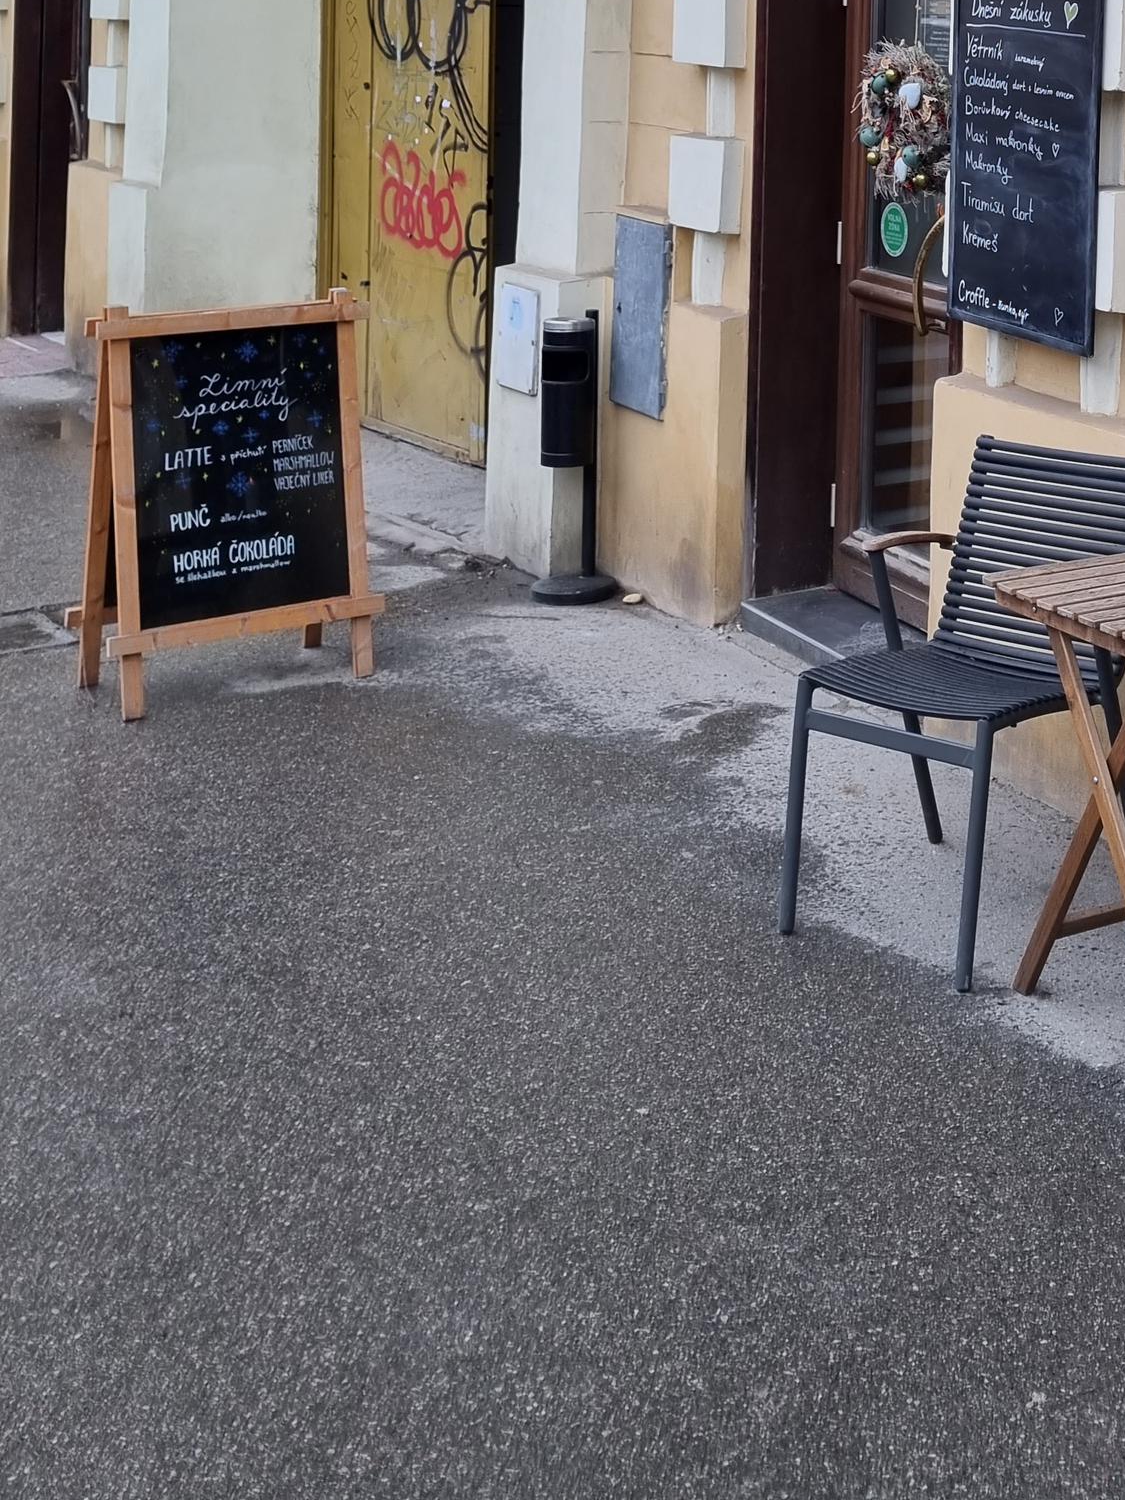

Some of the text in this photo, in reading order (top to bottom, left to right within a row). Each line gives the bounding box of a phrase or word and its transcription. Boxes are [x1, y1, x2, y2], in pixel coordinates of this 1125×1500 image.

[966, 32, 1003, 61] Větrník
[963, 58, 1010, 96] Čokoládový
[1014, 107, 1061, 133] cheesecake
[965, 122, 1044, 161] Maxi makronky
[965, 149, 1014, 185] Makronky
[961, 181, 1034, 224] Tiramisu dort
[962, 220, 998, 253] Kremeš
[958, 279, 991, 308] Croffle
[199, 367, 288, 398] Zimní
[172, 387, 299, 431] speciality
[164, 445, 214, 471] LATTE
[271, 433, 315, 454] PERNÍČEK
[272, 451, 336, 472] MARSHMALLOW
[169, 503, 211, 533] PUNČ
[172, 531, 296, 573] HORKÁ ČOKOLÁDA
